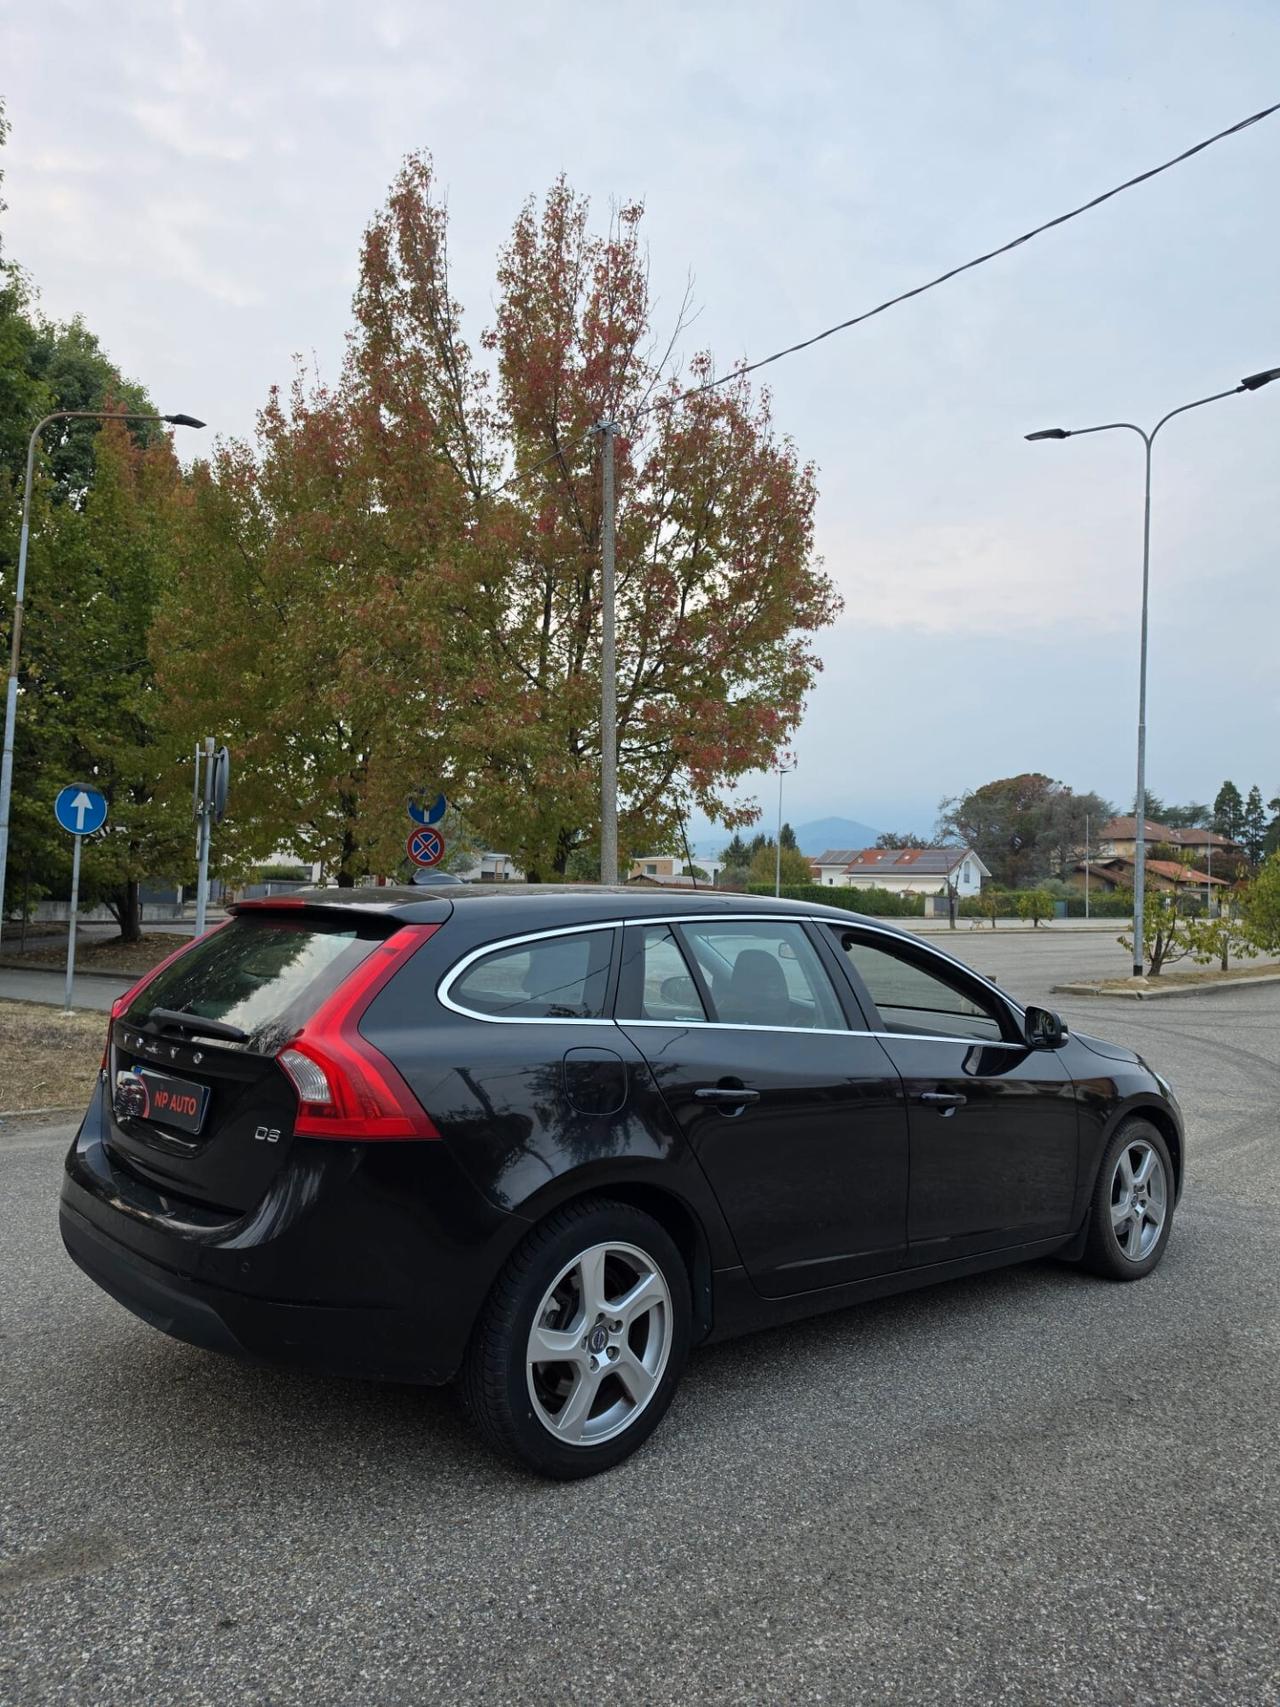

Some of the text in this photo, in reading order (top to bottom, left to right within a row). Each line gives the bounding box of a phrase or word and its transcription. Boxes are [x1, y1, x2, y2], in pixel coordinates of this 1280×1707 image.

[154, 1090, 197, 1115] NP AUTO
[254, 1126, 281, 1143] D3
